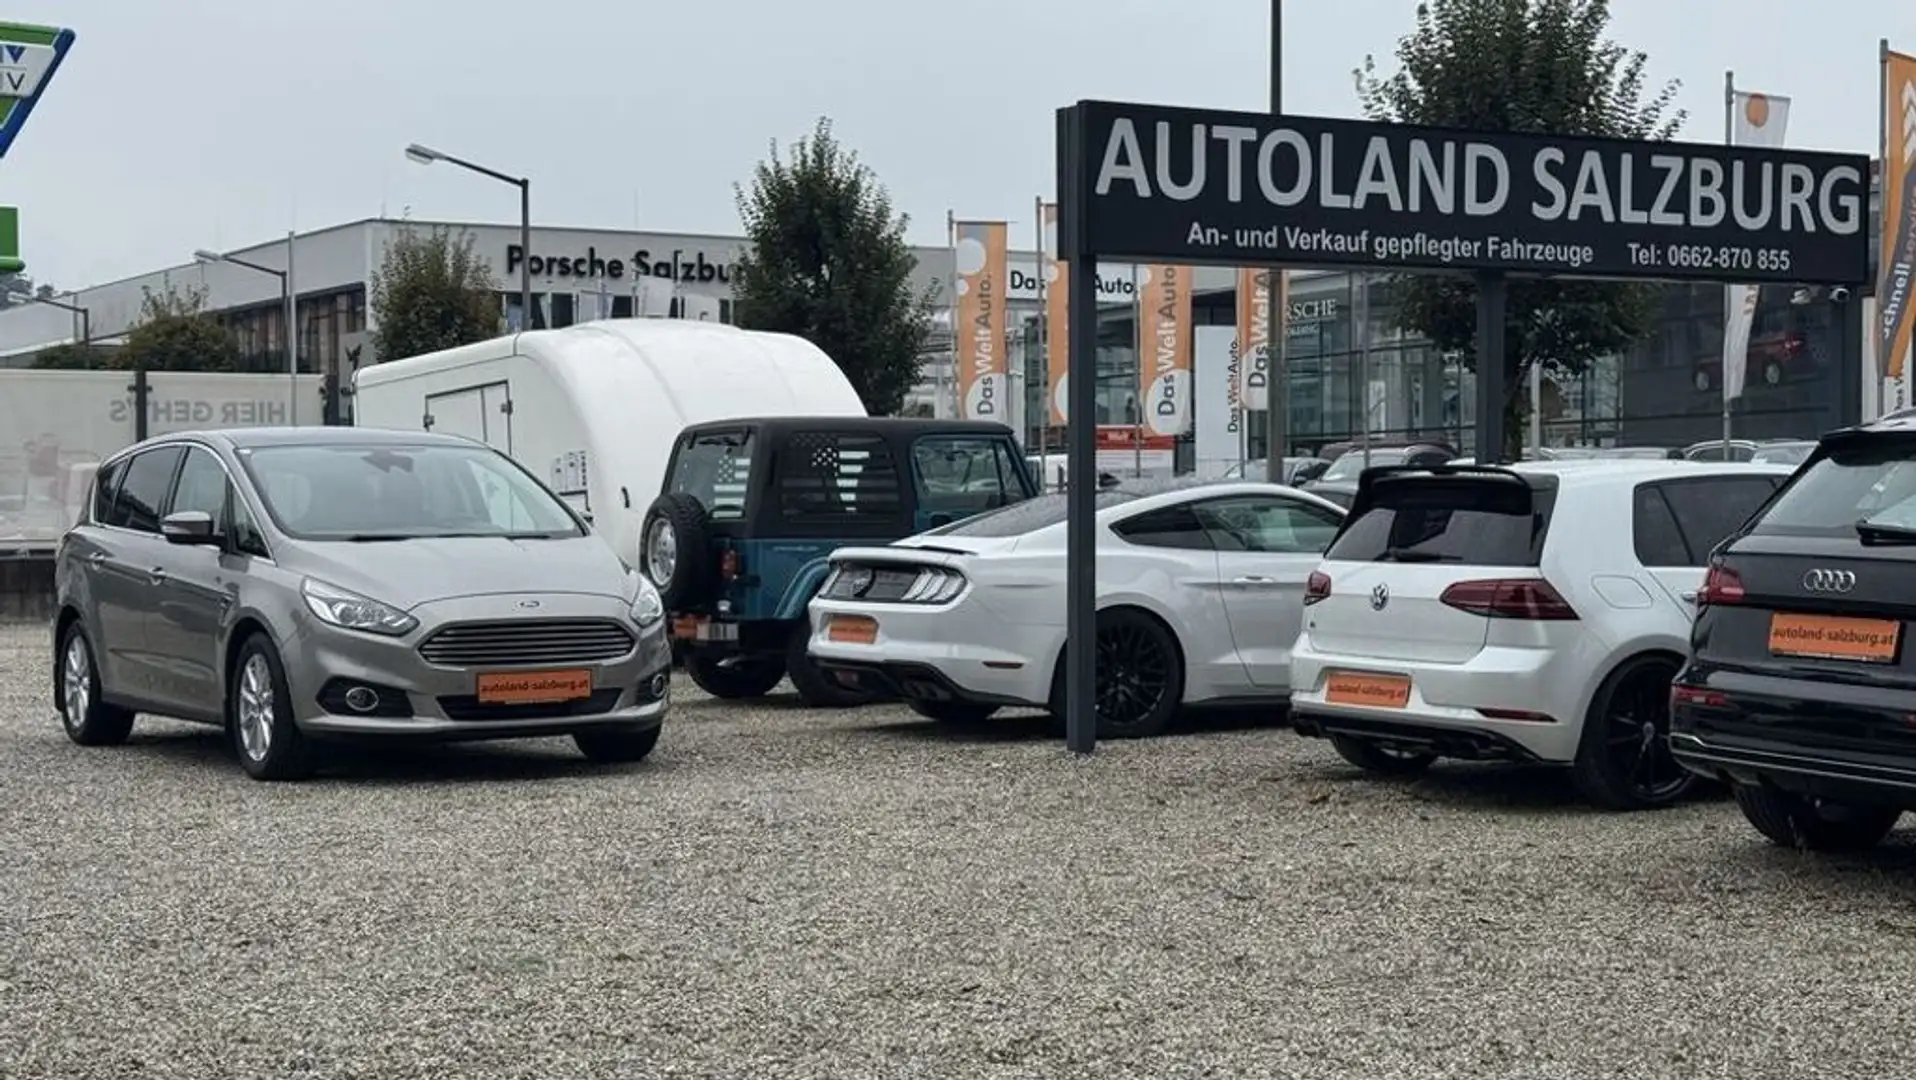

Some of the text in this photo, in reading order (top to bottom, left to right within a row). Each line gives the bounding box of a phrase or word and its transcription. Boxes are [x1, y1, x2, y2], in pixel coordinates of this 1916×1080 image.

[1095, 117, 1860, 235] AUTOLAND SALZBURG
[507, 244, 732, 284] Porsche Salzbu
[1187, 221, 1790, 271] An- und Verkauf gepflegter Fahrzeuge Tel: 0662-870 855
[977, 376, 994, 415] Das
[1157, 374, 1175, 416] Das
[1773, 626, 1894, 647] autoland-salzburg.at
